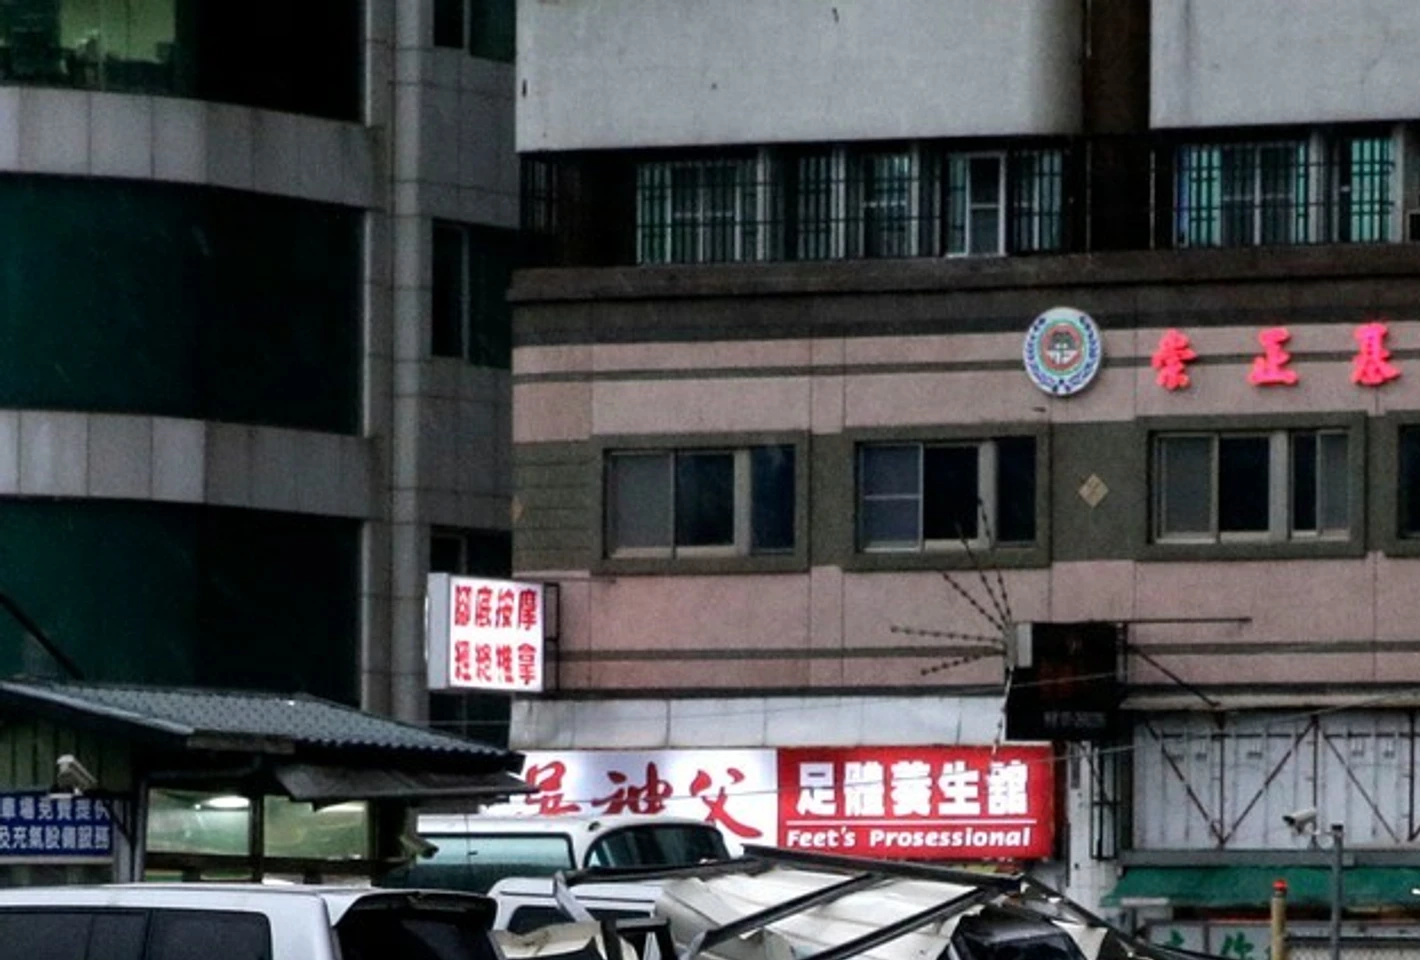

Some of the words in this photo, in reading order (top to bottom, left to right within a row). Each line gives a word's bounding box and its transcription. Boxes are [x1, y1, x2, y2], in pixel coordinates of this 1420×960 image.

[797, 760, 1028, 817] 足體養生館
[786, 827, 856, 848] Feet's
[869, 827, 1031, 848] Prosessional
